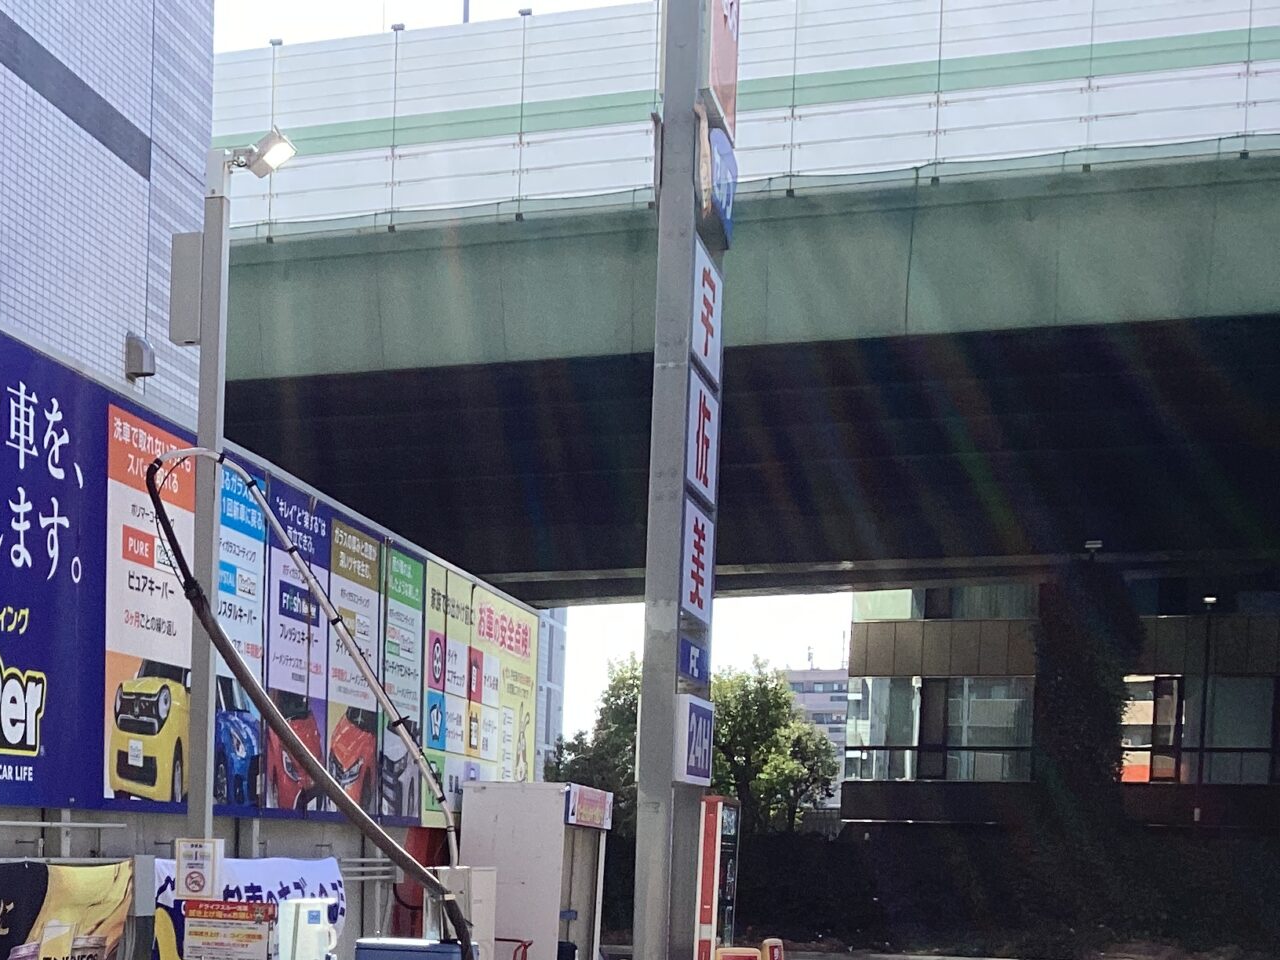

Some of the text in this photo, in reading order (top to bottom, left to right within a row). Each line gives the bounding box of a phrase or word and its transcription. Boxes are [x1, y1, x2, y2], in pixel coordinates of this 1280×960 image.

[127, 536, 150, 559] PURE
[127, 569, 175, 600] ピュアキーパー
[688, 712, 712, 775] 24H
[15, 766, 34, 782] LIFE
